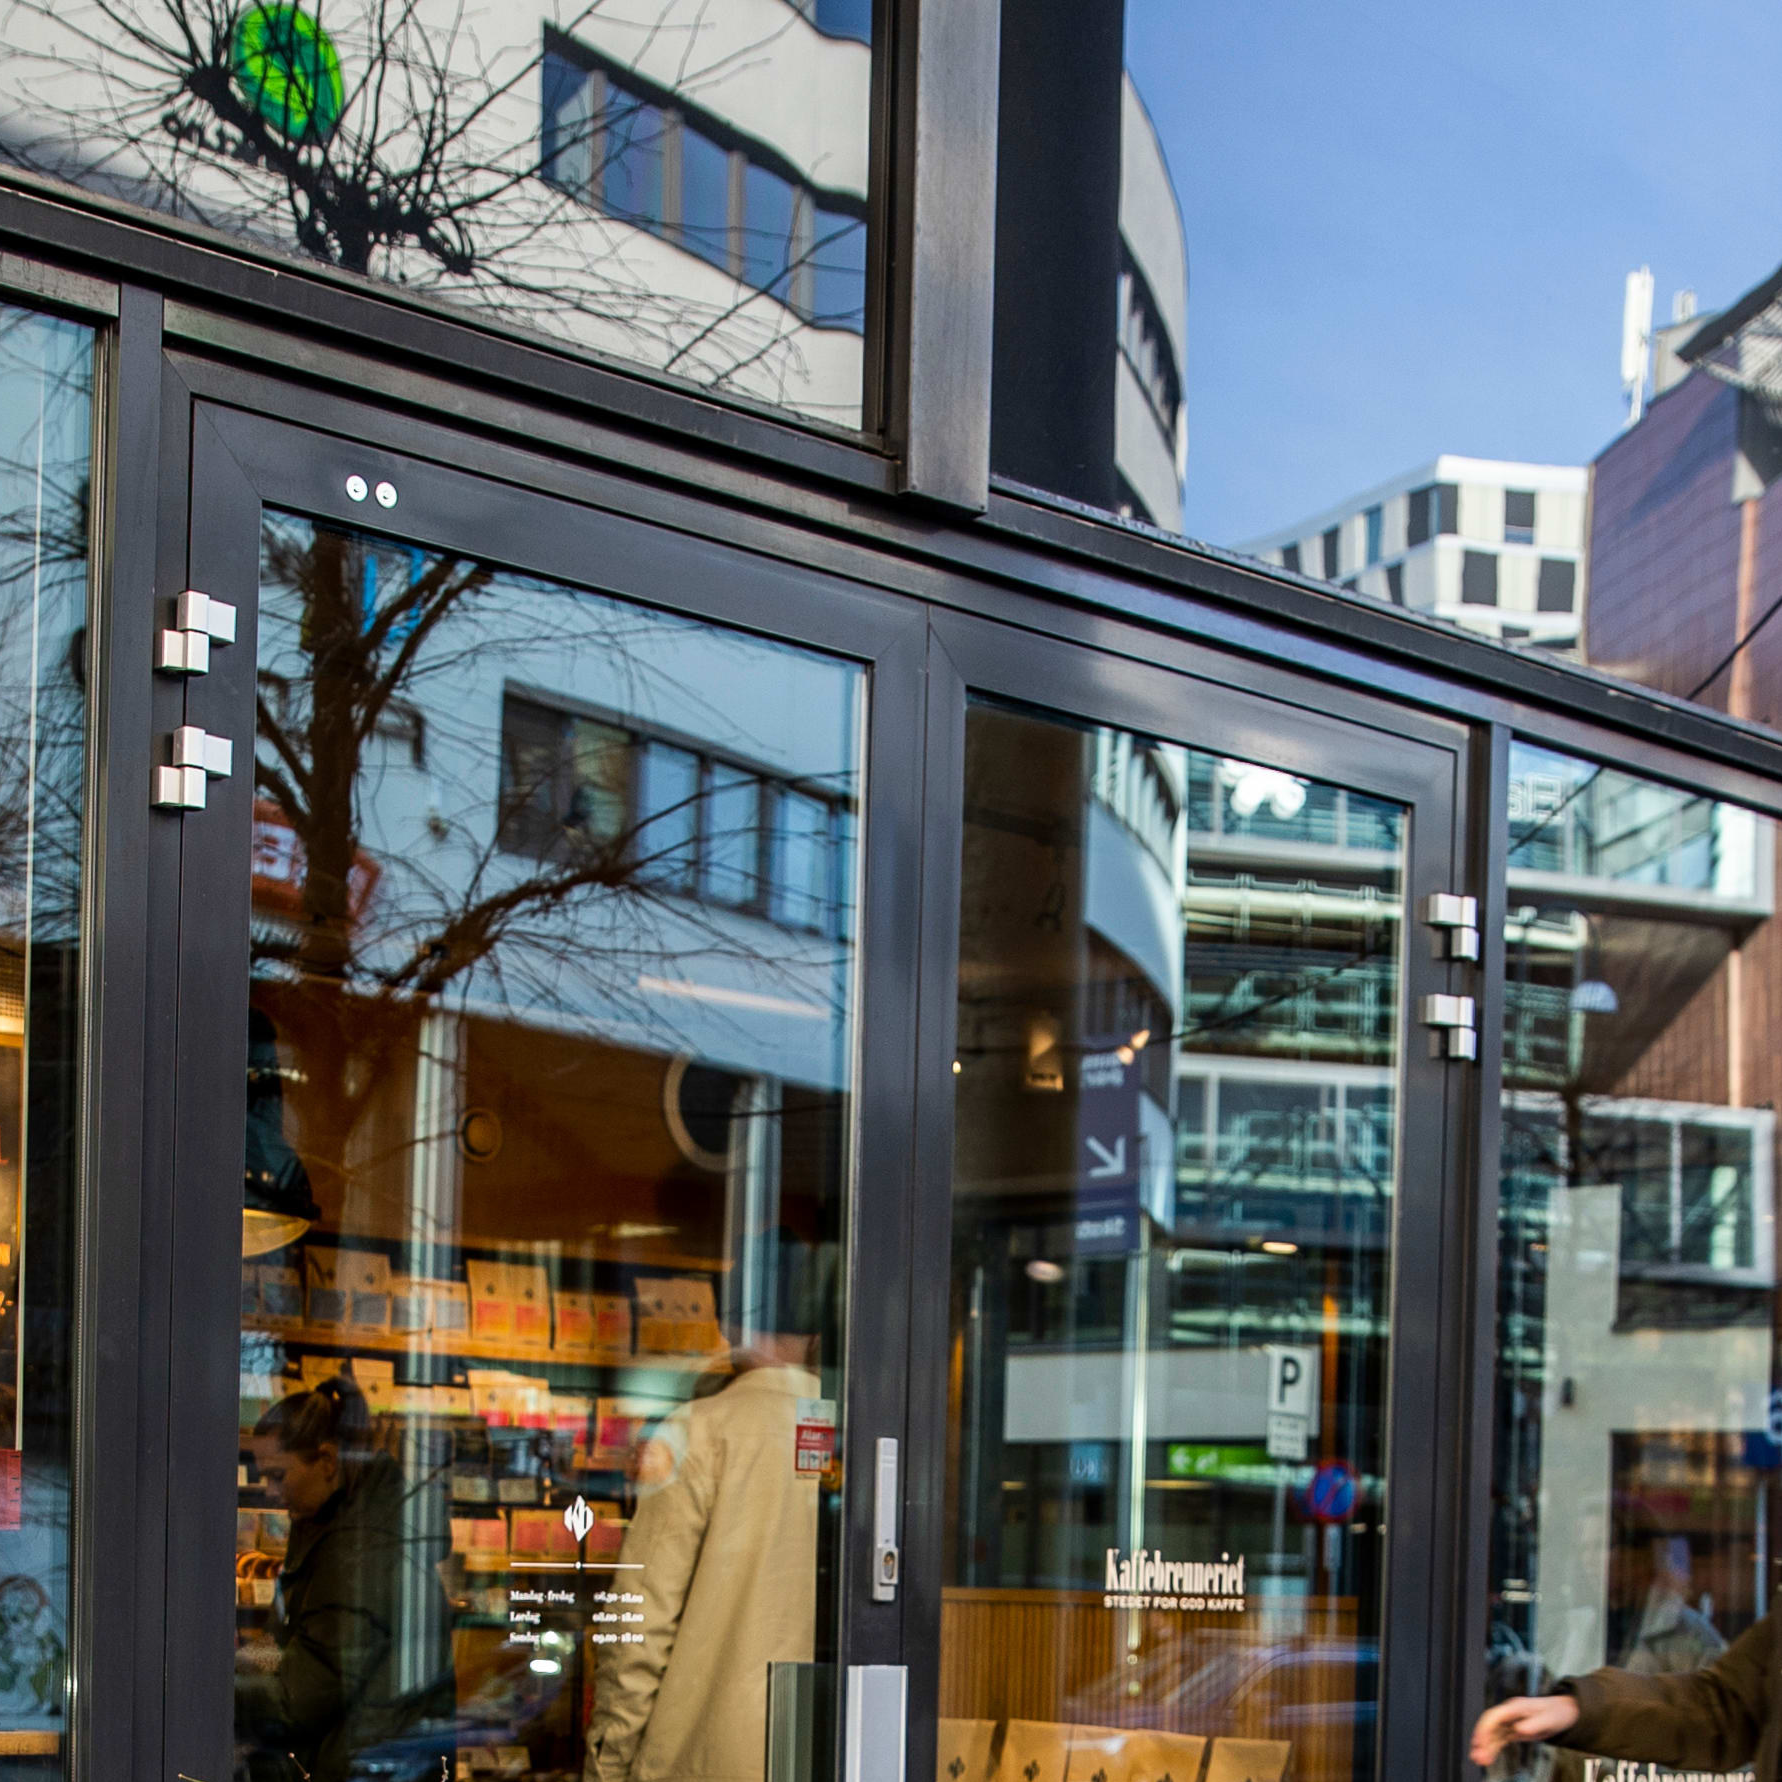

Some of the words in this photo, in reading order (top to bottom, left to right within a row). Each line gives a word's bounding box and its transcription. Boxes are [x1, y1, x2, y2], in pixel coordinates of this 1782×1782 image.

[1279, 1357, 1301, 1402] P
[1105, 1548, 1246, 1596] Kaffebrenneriet
[1103, 1594, 1151, 1610] STEDET
[1153, 1596, 1178, 1610] FOR
[1179, 1597, 1206, 1611] GOD
[1207, 1598, 1246, 1612] KAFFE
